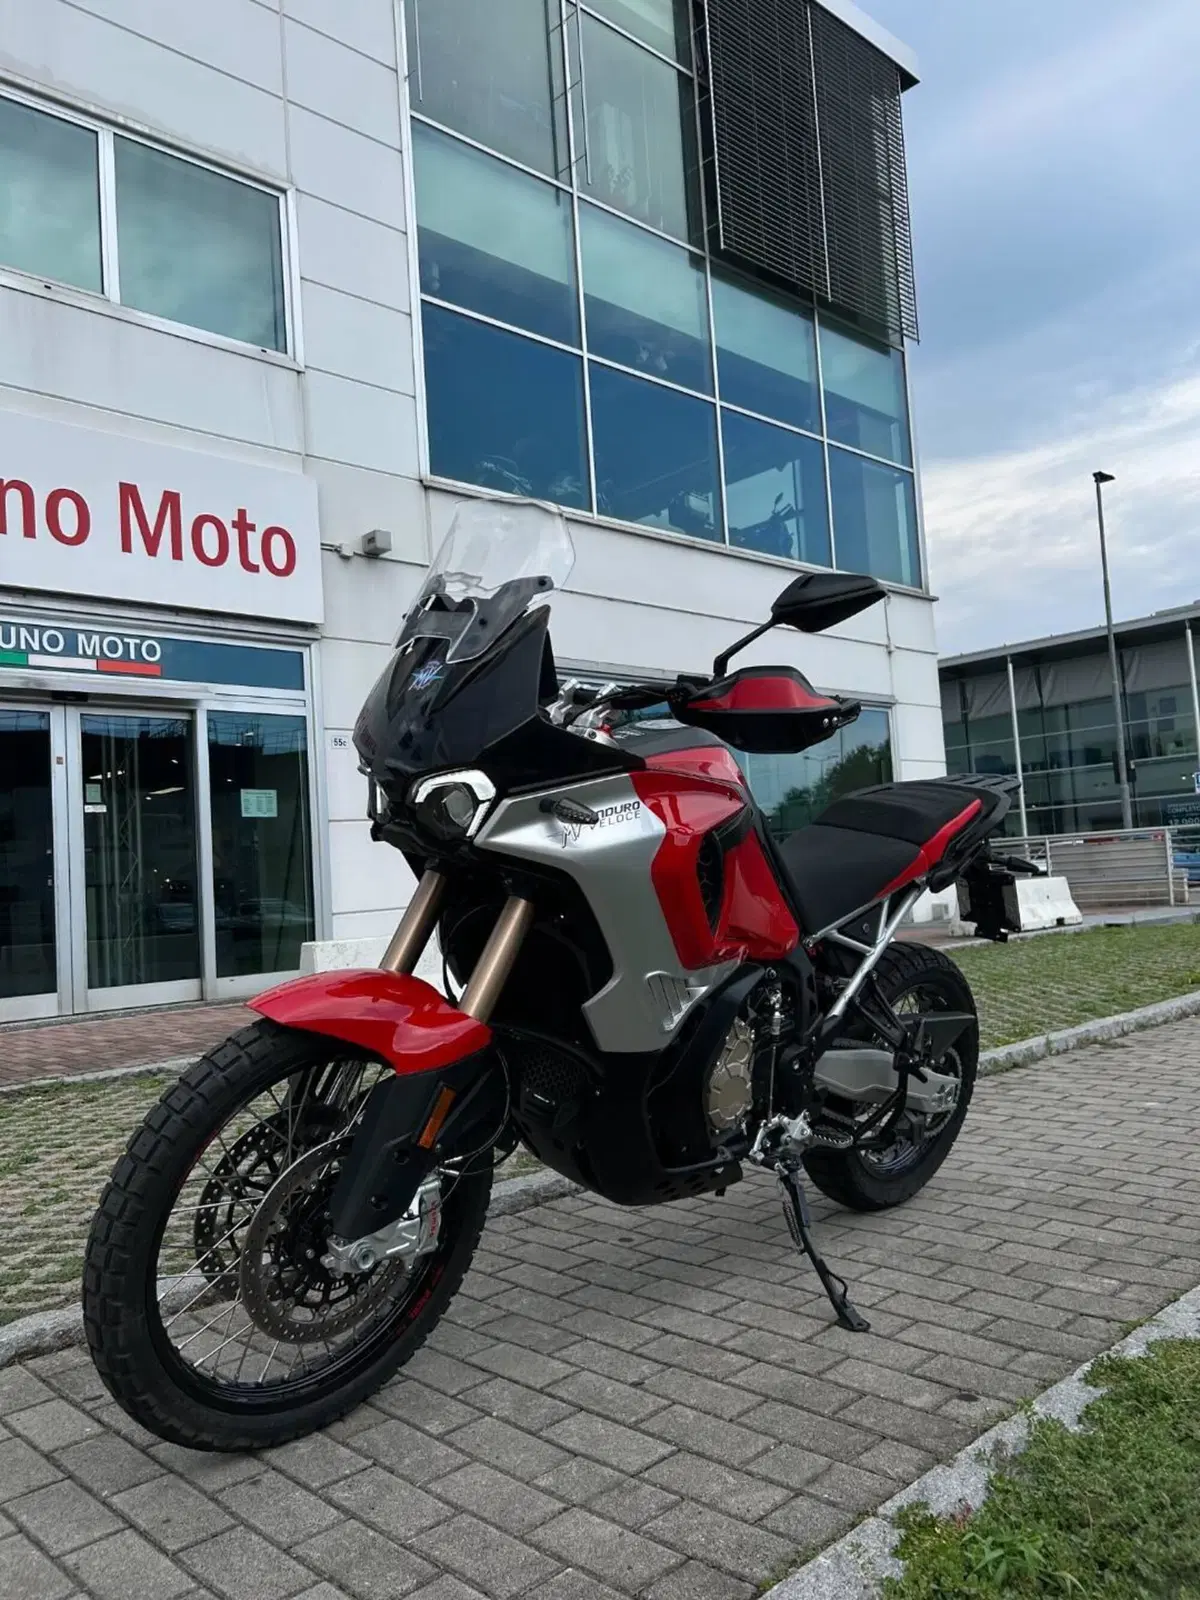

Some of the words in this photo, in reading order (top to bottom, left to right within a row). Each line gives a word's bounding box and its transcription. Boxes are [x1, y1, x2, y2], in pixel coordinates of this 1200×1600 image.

[118, 481, 297, 578] Moto
[0, 625, 65, 653] UNO
[77, 633, 162, 662] MOTO
[596, 800, 641, 818] NDURO
